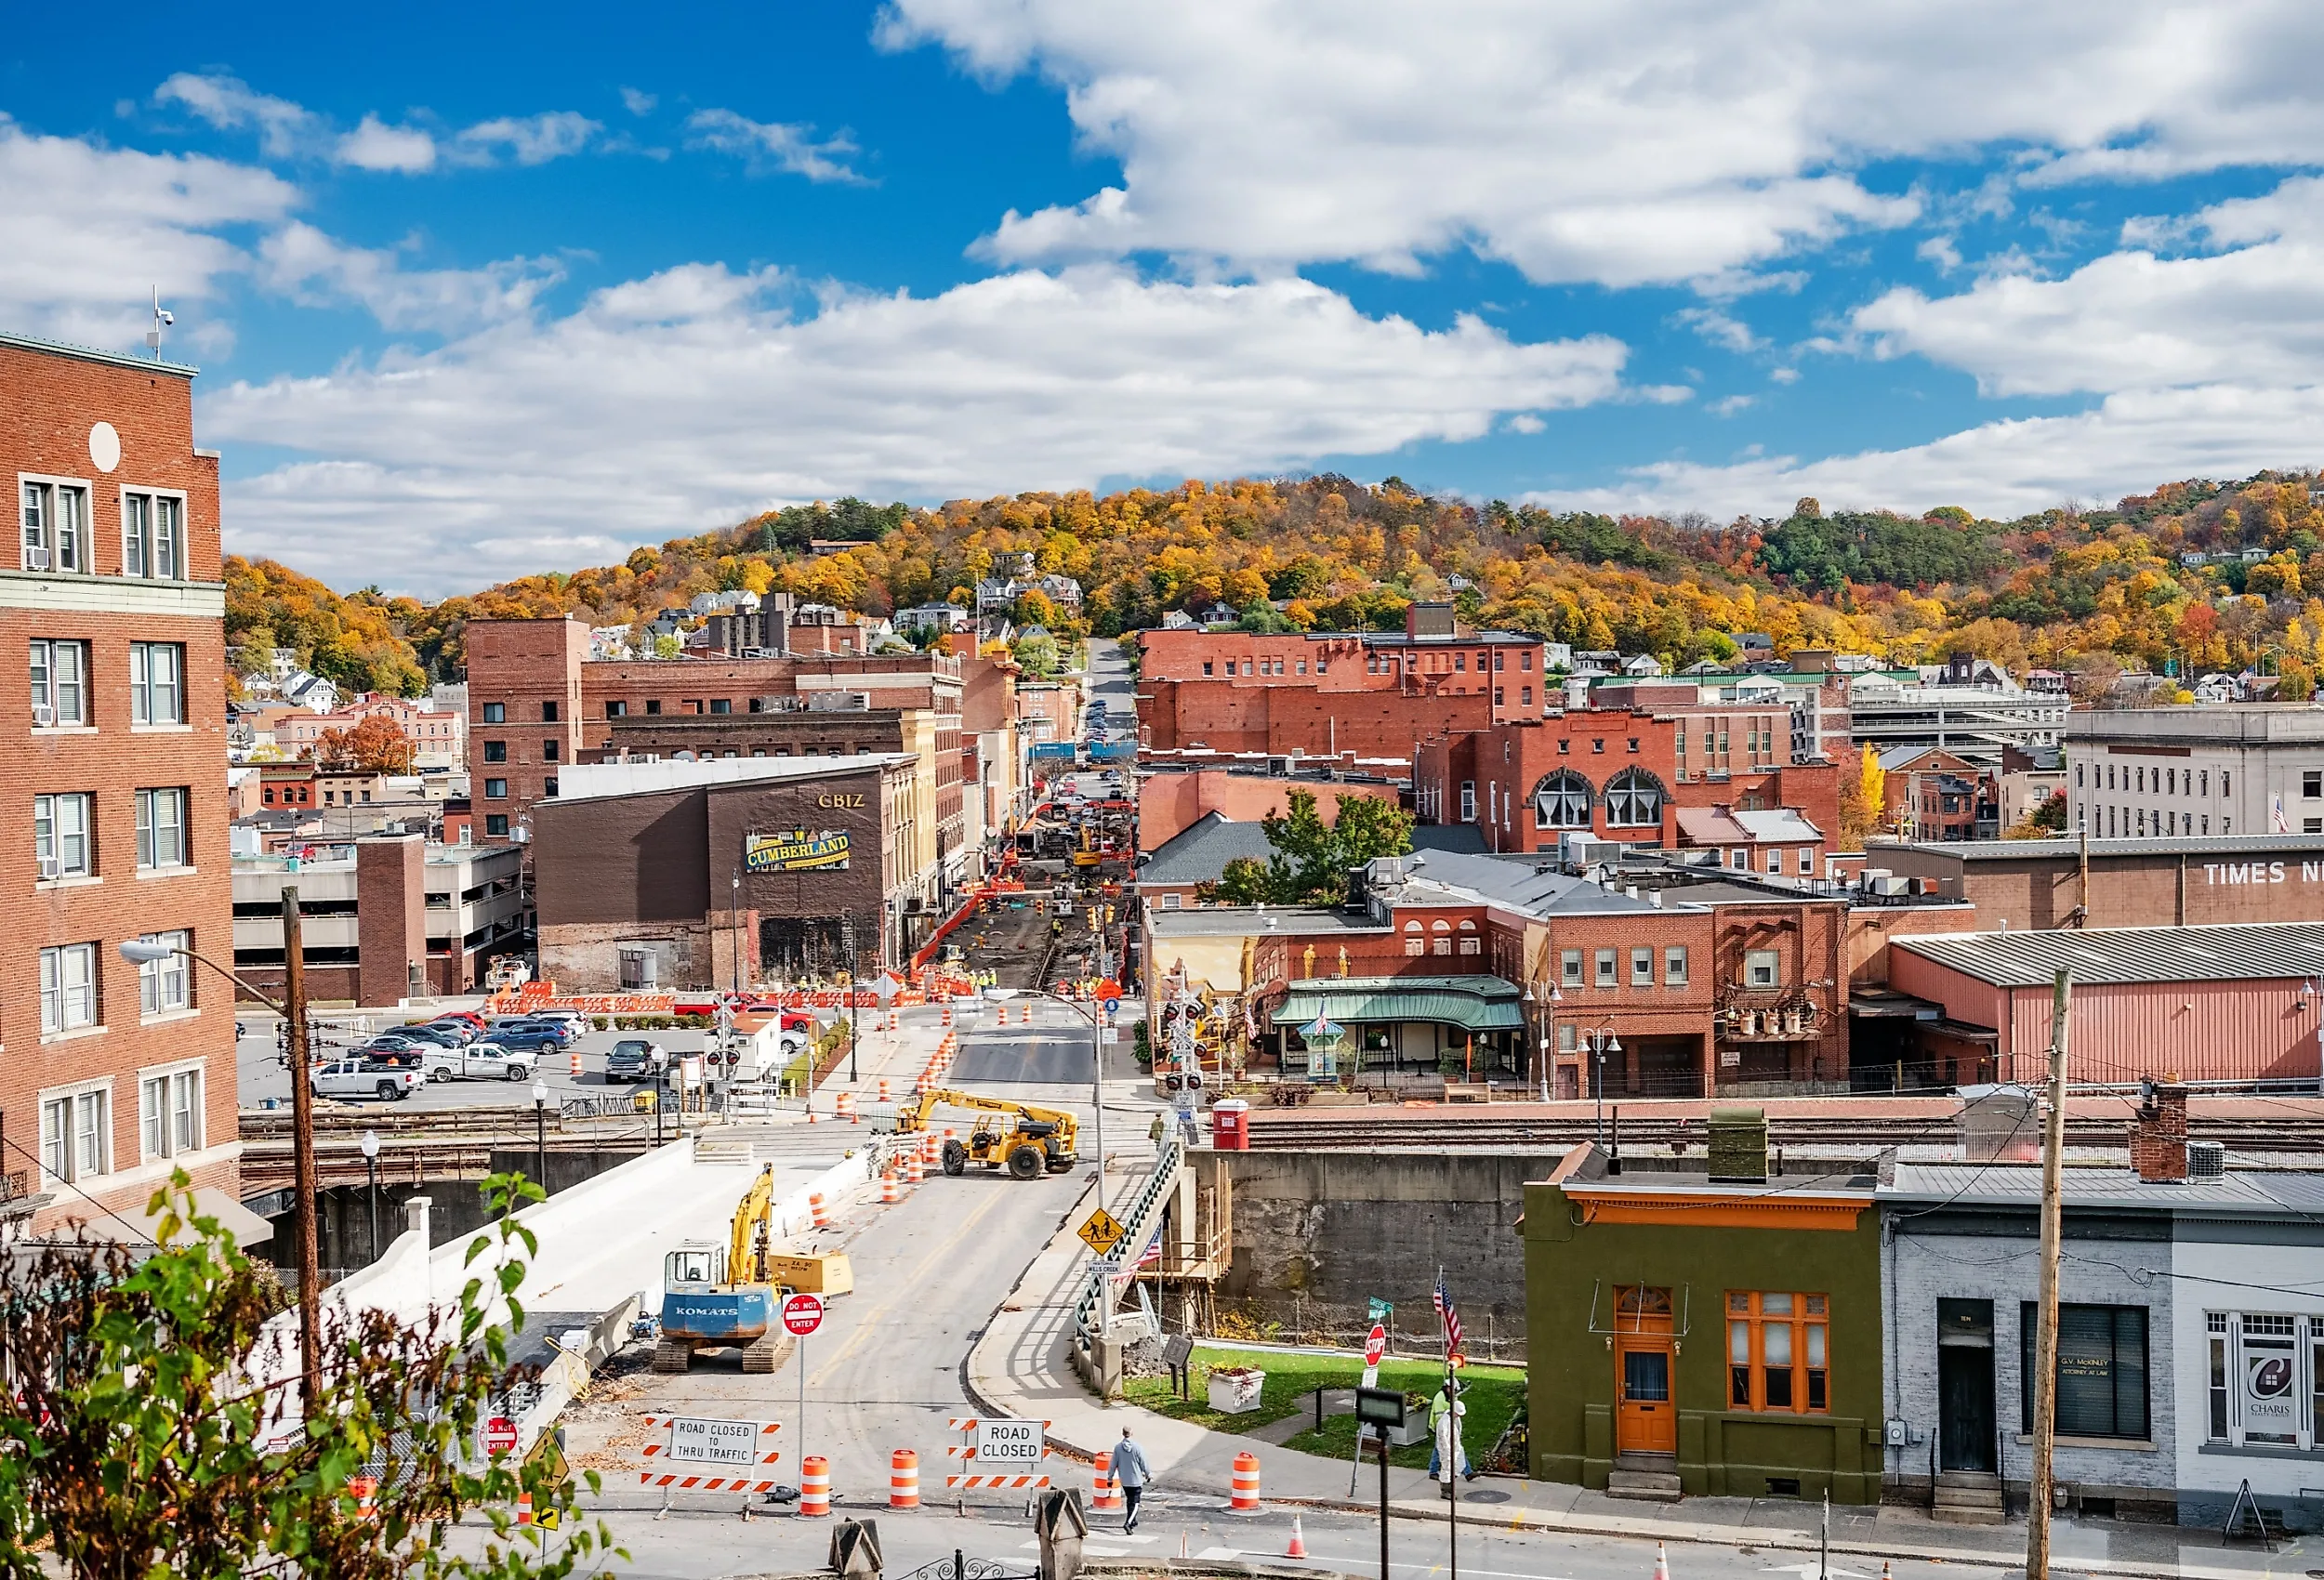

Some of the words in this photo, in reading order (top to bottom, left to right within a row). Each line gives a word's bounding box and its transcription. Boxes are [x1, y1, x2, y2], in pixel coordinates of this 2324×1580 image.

[819, 794, 865, 808] CBIZ
[747, 836, 849, 866] CUMBERLAND
[2203, 861, 2285, 885] TIMES
[2302, 861, 2324, 882] N
[789, 1302, 799, 1310] DO
[791, 1320, 814, 1328] ENTER
[1367, 1337, 1384, 1355] STOP
[2251, 1403, 2290, 1414] CHARIS
[680, 1423, 705, 1434] ROAD
[710, 1425, 749, 1437] CLOSED
[991, 1427, 1030, 1440] ROAD
[708, 1437, 719, 1445] TO
[678, 1445, 704, 1457] THRU
[708, 1448, 747, 1460] TRAFFIC
[983, 1443, 1037, 1457] CLOSED
